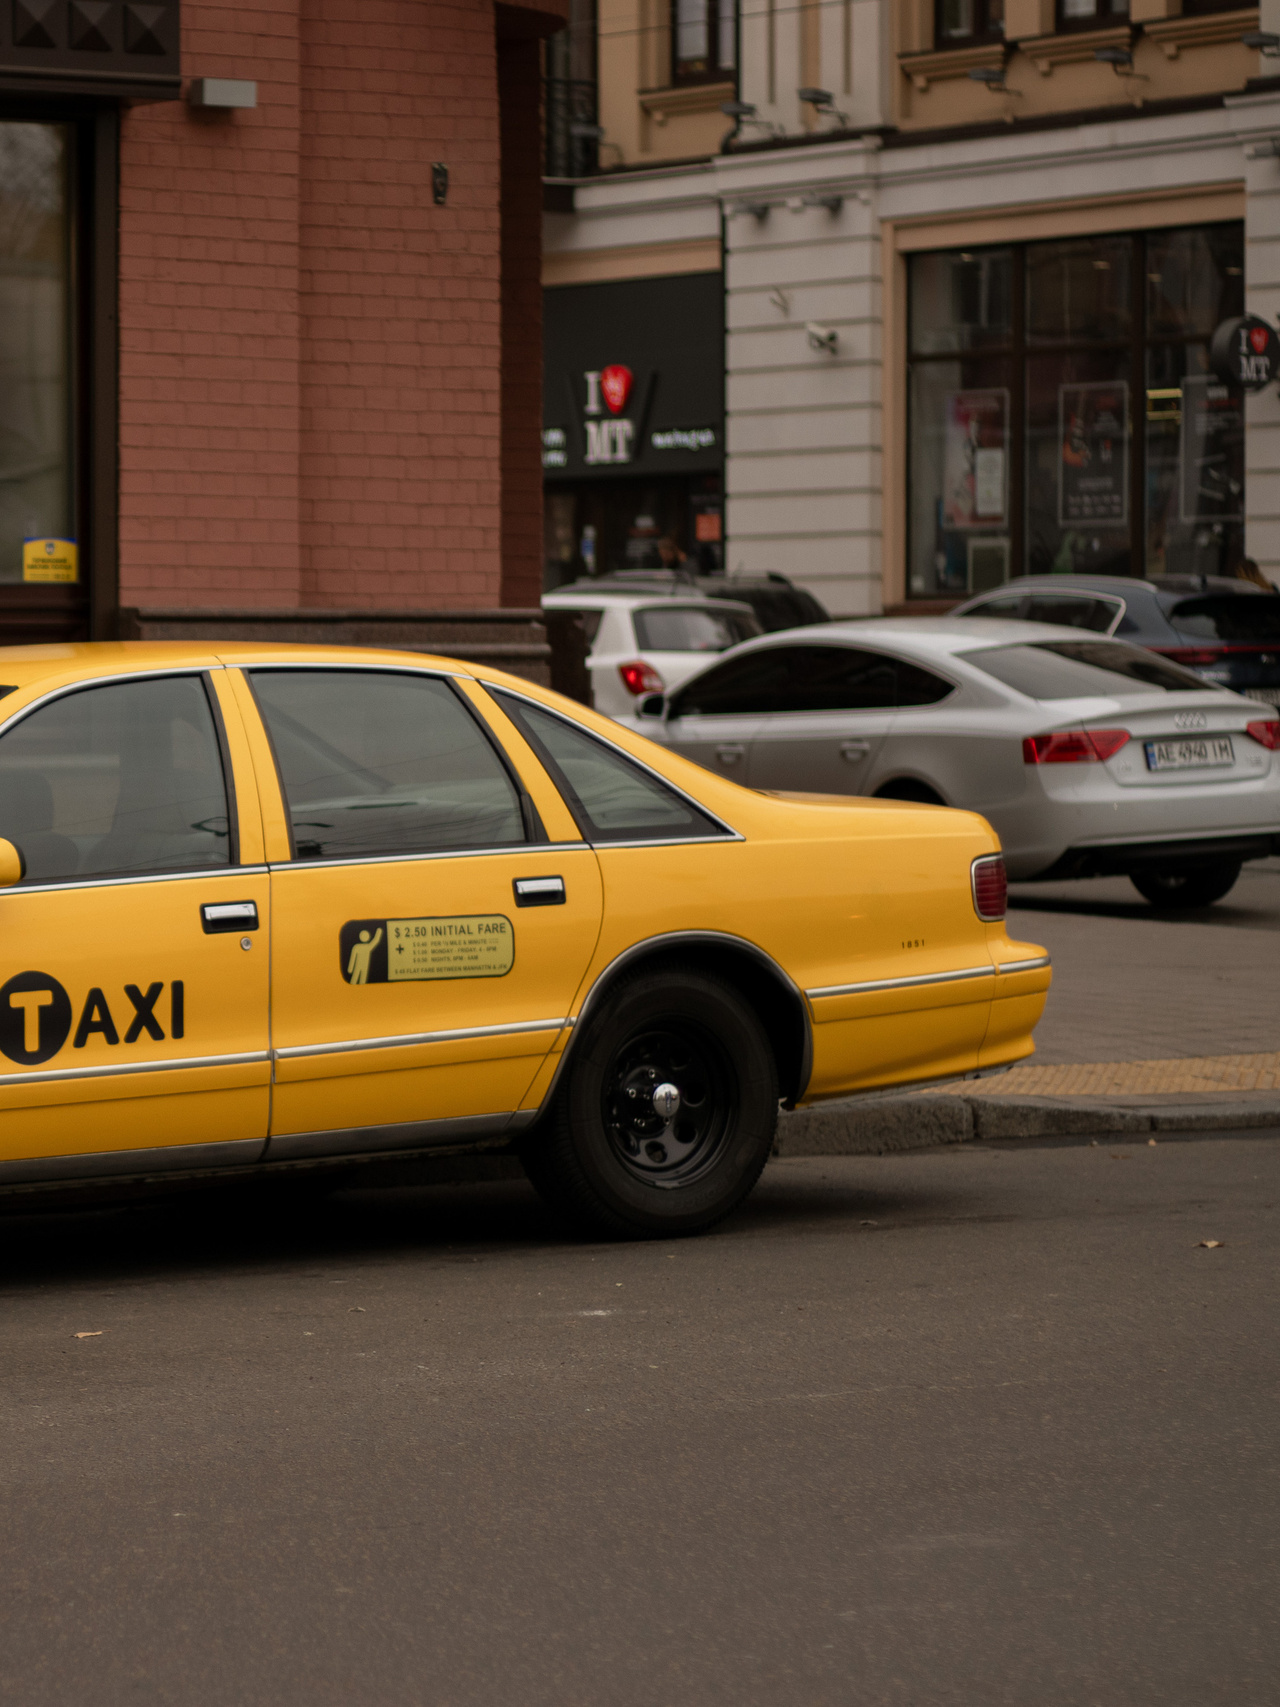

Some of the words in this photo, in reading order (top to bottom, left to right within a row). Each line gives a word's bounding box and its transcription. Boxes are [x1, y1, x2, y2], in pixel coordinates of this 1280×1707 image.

[1239, 328, 1249, 354] I
[1240, 355, 1270, 381] MT
[584, 370, 602, 415] I
[584, 418, 633, 465] MT
[1157, 742, 1176, 762] AE
[1178, 741, 1208, 761] 4940
[404, 926, 426, 938] 2.50
[431, 924, 473, 936] INITIAL
[478, 922, 506, 934] FARE
[902, 939, 924, 948] 1851
